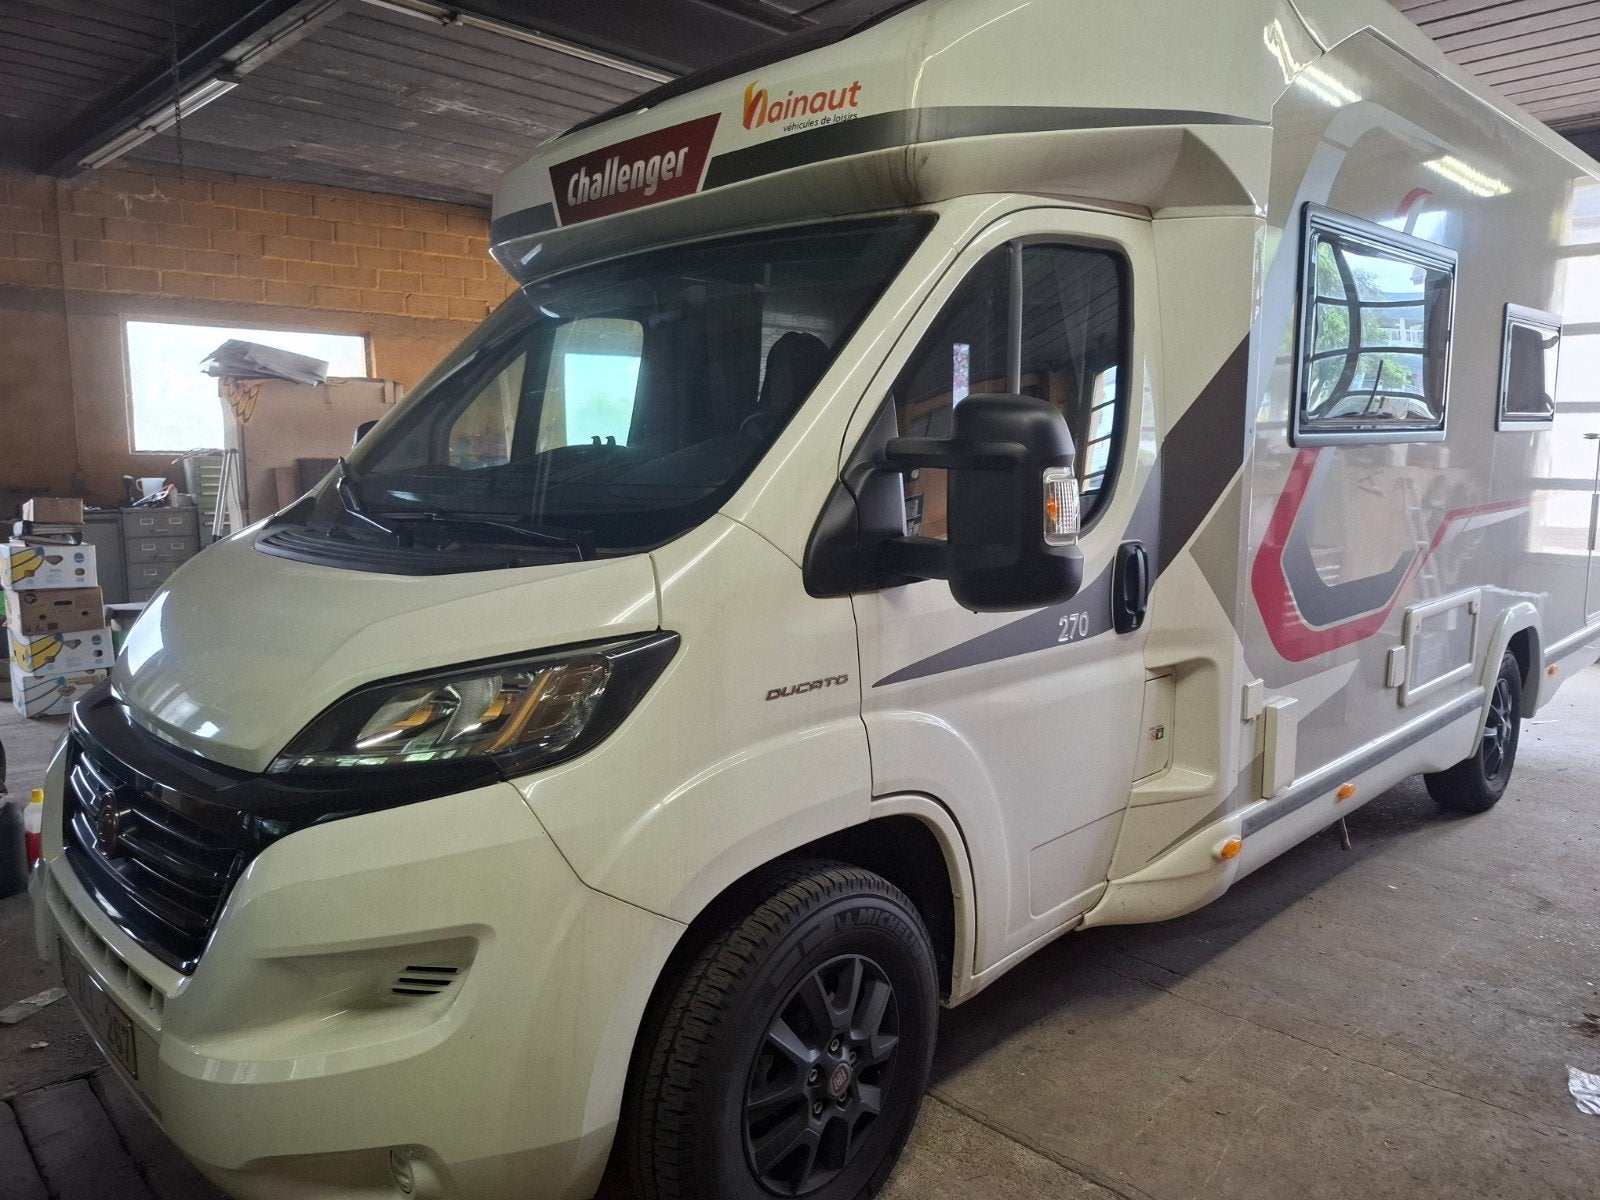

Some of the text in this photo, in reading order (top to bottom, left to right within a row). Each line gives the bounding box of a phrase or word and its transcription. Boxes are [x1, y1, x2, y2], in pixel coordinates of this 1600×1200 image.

[783, 111, 859, 133] véhicules de loisirs
[567, 147, 689, 206] Challenger
[1058, 611, 1090, 642] 270
[765, 673, 850, 701] DUCATO
